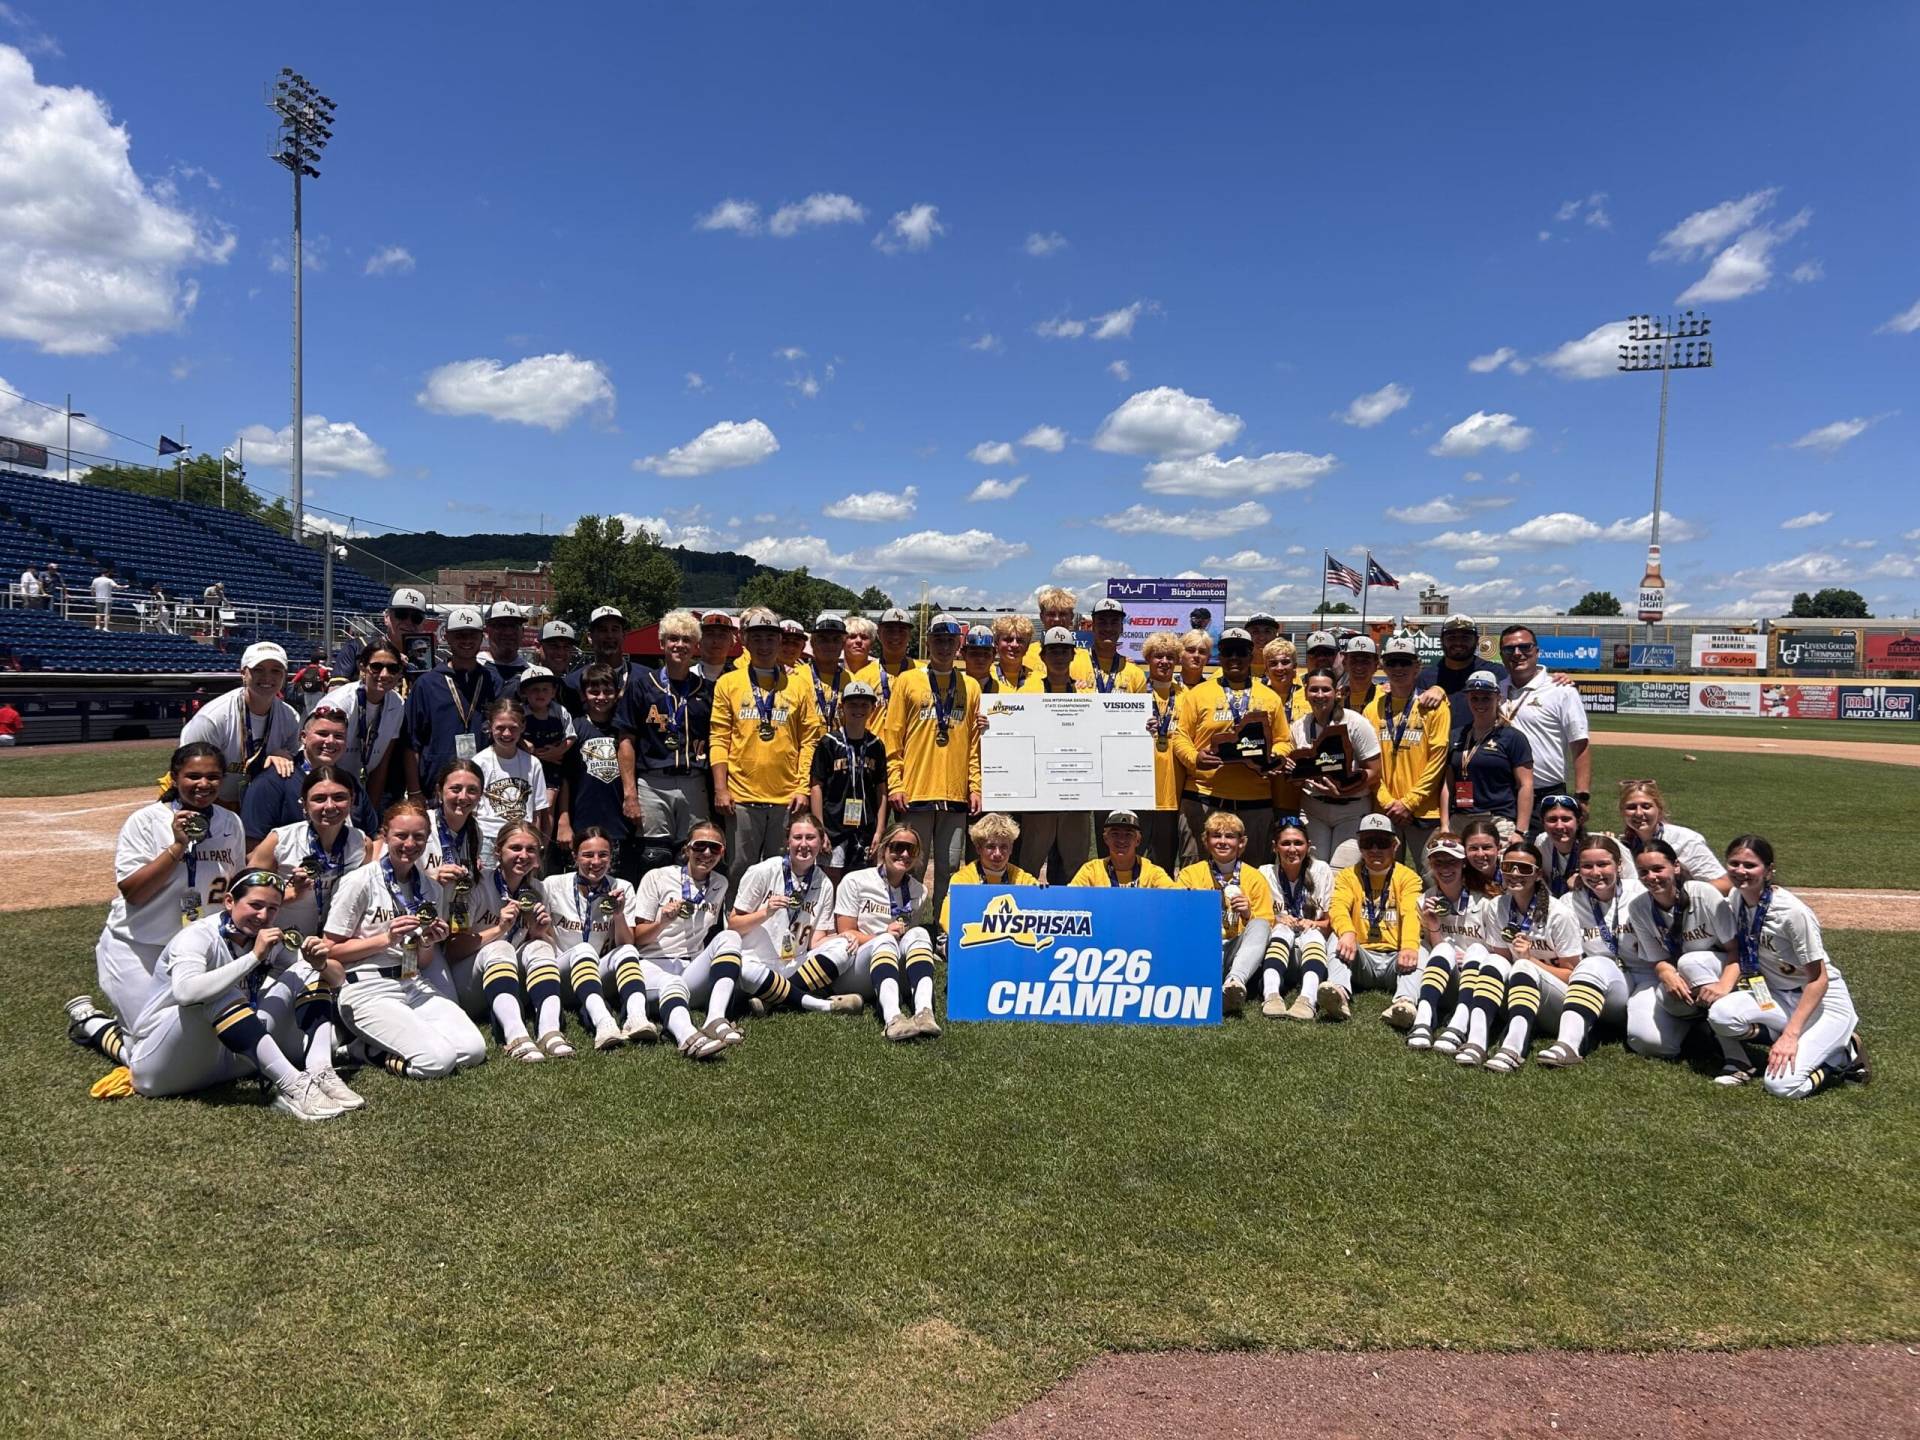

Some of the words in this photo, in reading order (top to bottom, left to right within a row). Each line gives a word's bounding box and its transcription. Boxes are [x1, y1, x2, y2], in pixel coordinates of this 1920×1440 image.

[1171, 588, 1225, 597] Binghamton
[1129, 617, 1154, 626] NEED
[1155, 617, 1178, 626] YOU!
[1538, 649, 1574, 659] Excellus
[1720, 655, 1753, 664] Kubota
[1578, 685, 1615, 693] PROVIDERS
[1642, 682, 1689, 692] Gallagher
[1705, 688, 1751, 696] Warehouse
[1598, 694, 1615, 702] Care
[1642, 691, 1672, 699] Baker,
[1675, 691, 1689, 699] PC
[1845, 686, 1910, 711] miller
[1593, 702, 1615, 711] Reach
[739, 708, 789, 721] CHAION
[210, 849, 235, 866] PARK
[861, 900, 891, 914] AVERIL
[556, 917, 583, 932] AVERI
[981, 914, 1092, 937] NYSPHSAA
[1683, 923, 1713, 942] PARK
[1530, 940, 1553, 952] ARK
[1049, 947, 1152, 984] 2026
[987, 981, 1212, 1019] CHAMPION
